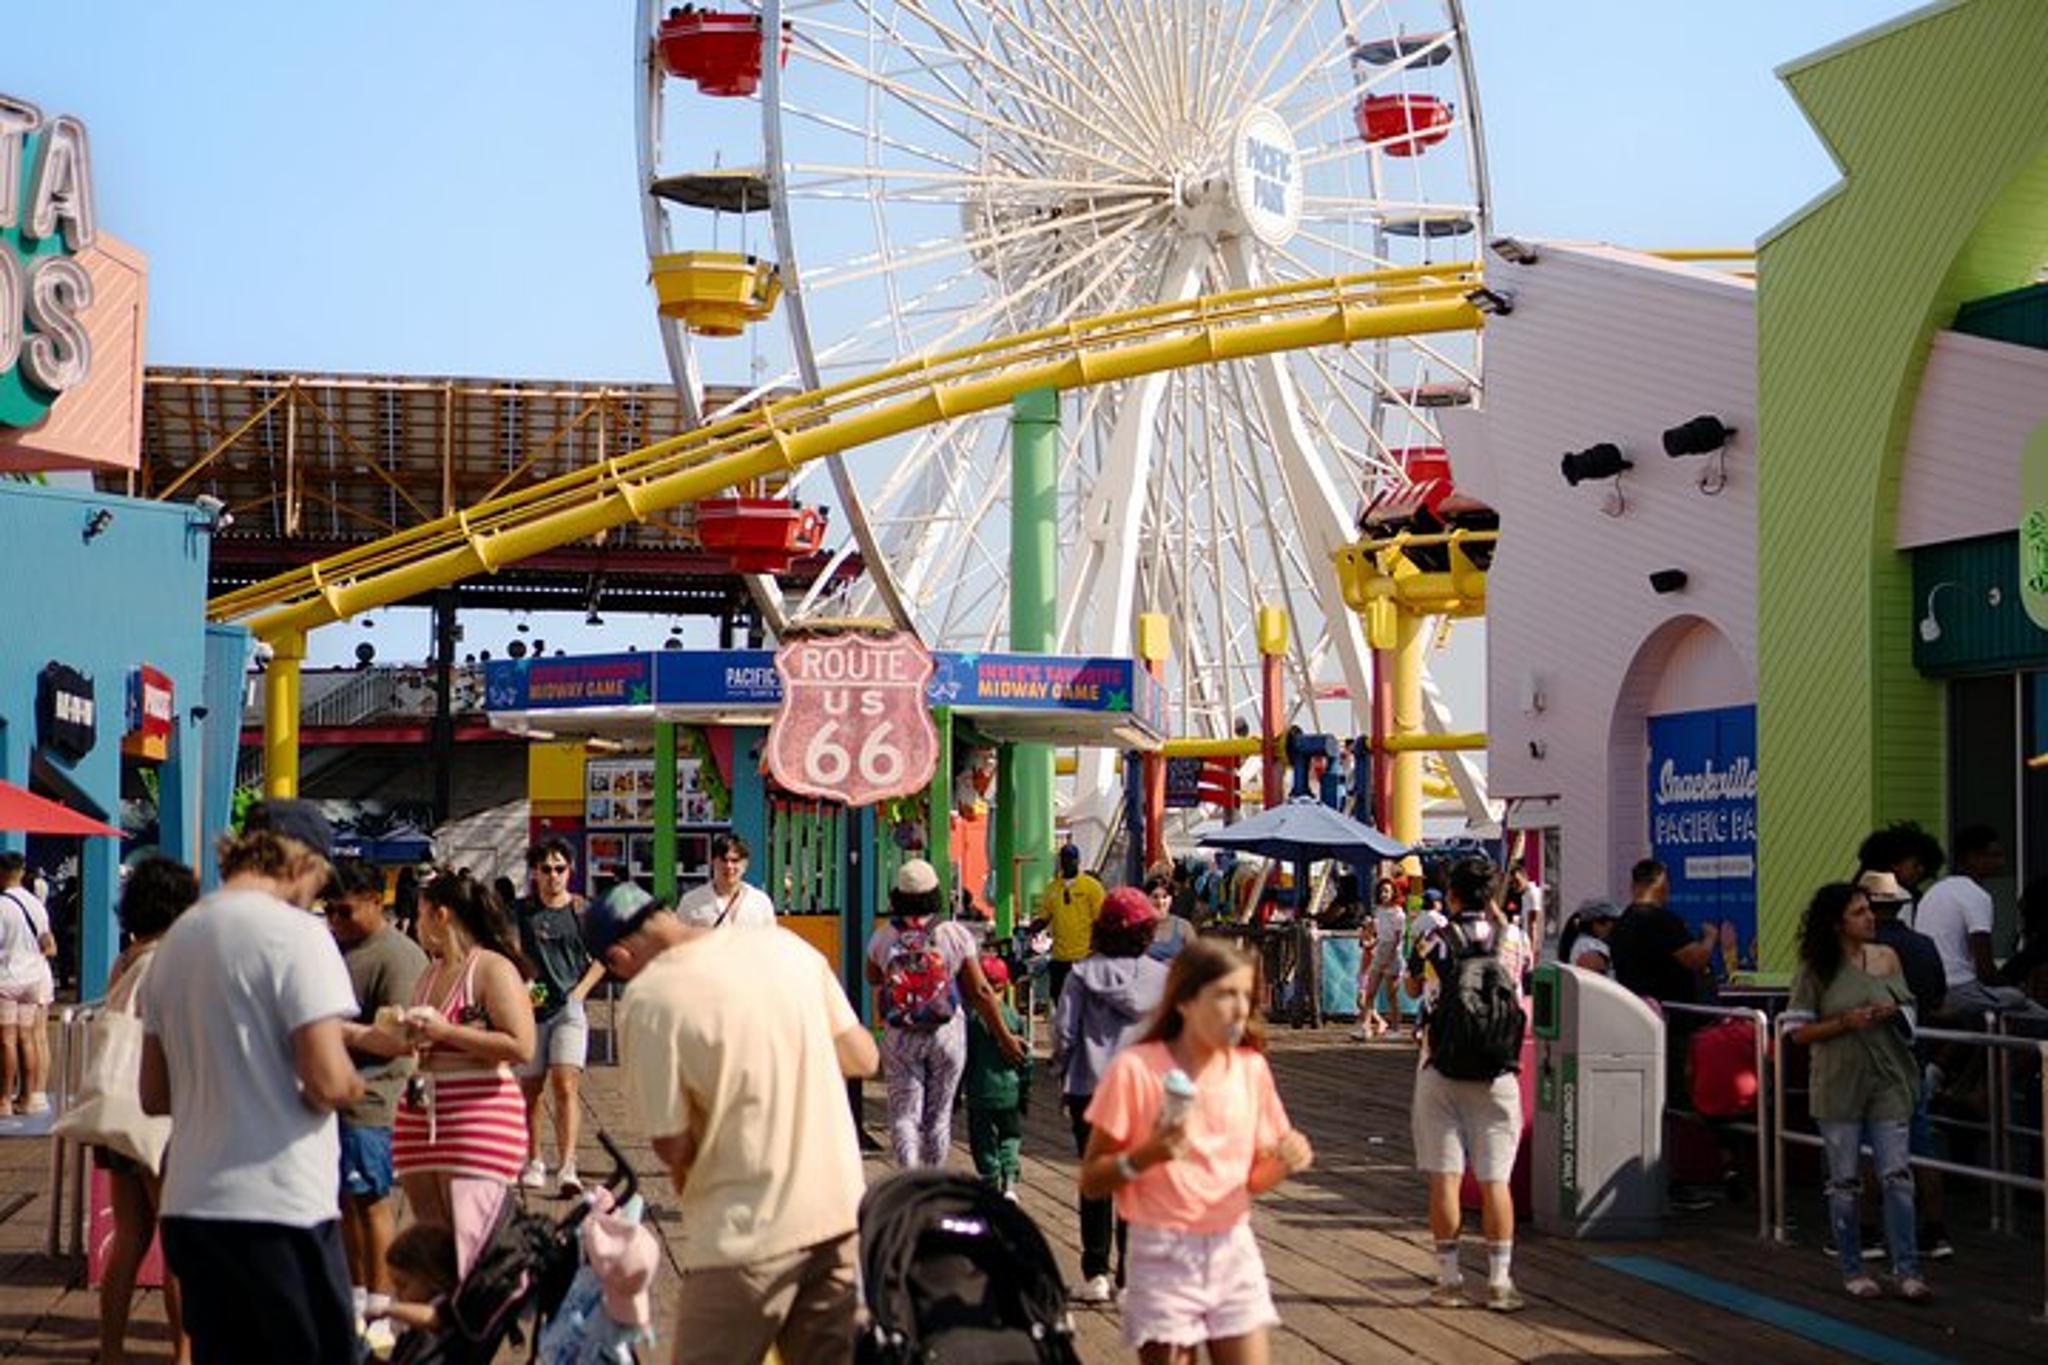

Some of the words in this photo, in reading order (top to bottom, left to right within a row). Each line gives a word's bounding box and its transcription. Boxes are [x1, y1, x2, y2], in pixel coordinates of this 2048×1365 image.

[801, 648, 908, 681] ROUTE
[586, 679, 625, 697] GAME
[978, 680, 1047, 699] MIDWAY
[1052, 684, 1100, 701] GAME
[805, 720, 902, 785] 66
[1656, 809, 1727, 845] PACIFIC
[1562, 1153, 1574, 1190] ONLY
